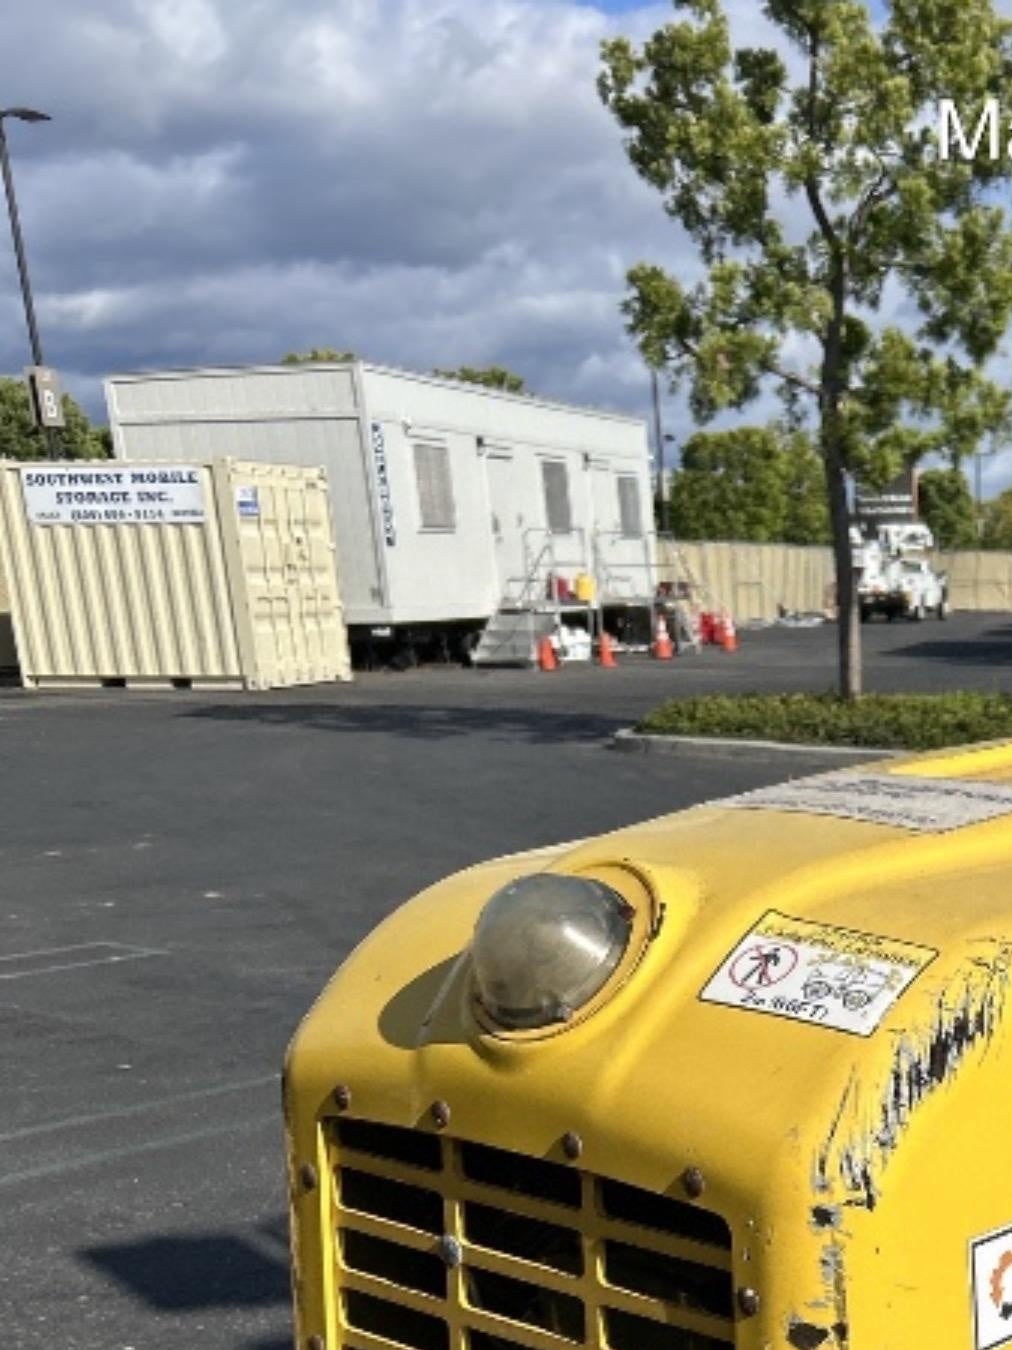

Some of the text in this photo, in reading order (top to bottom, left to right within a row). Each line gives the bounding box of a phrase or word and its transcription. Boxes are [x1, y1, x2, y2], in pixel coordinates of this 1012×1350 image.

[26, 470, 199, 487] SOUTHWEST MOBILE
[56, 491, 129, 505] STORAGE
